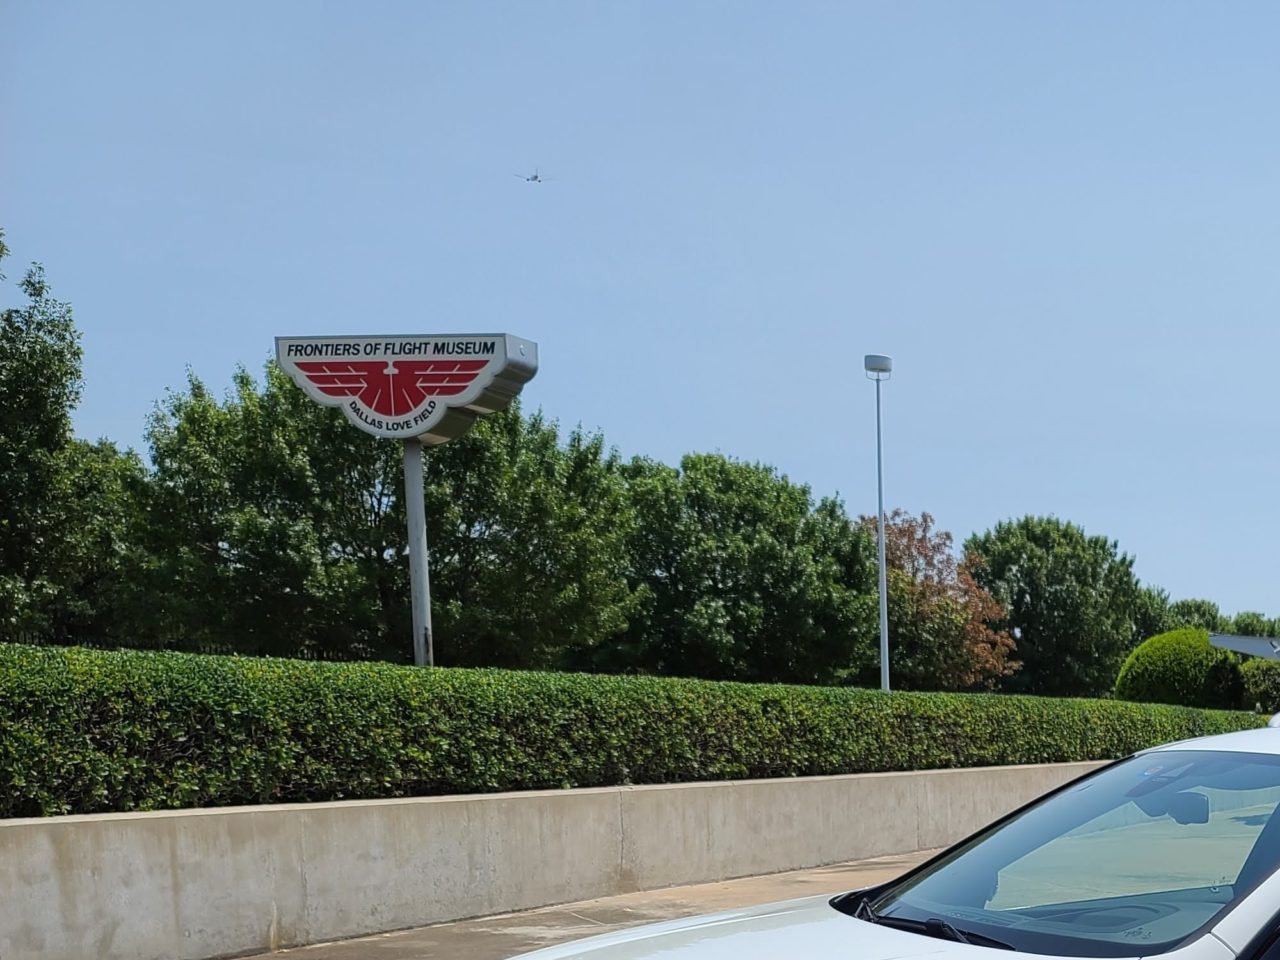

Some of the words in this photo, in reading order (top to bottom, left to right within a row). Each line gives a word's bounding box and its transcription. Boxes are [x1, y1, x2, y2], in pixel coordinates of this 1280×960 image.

[287, 343, 361, 356] FRONTIERS
[363, 342, 381, 356] OF
[383, 341, 431, 355] FLIGHT
[432, 341, 496, 355] MUSEUM
[349, 400, 383, 430] DALLAS
[385, 420, 413, 432] LOVE
[414, 400, 437, 426] FIELD
